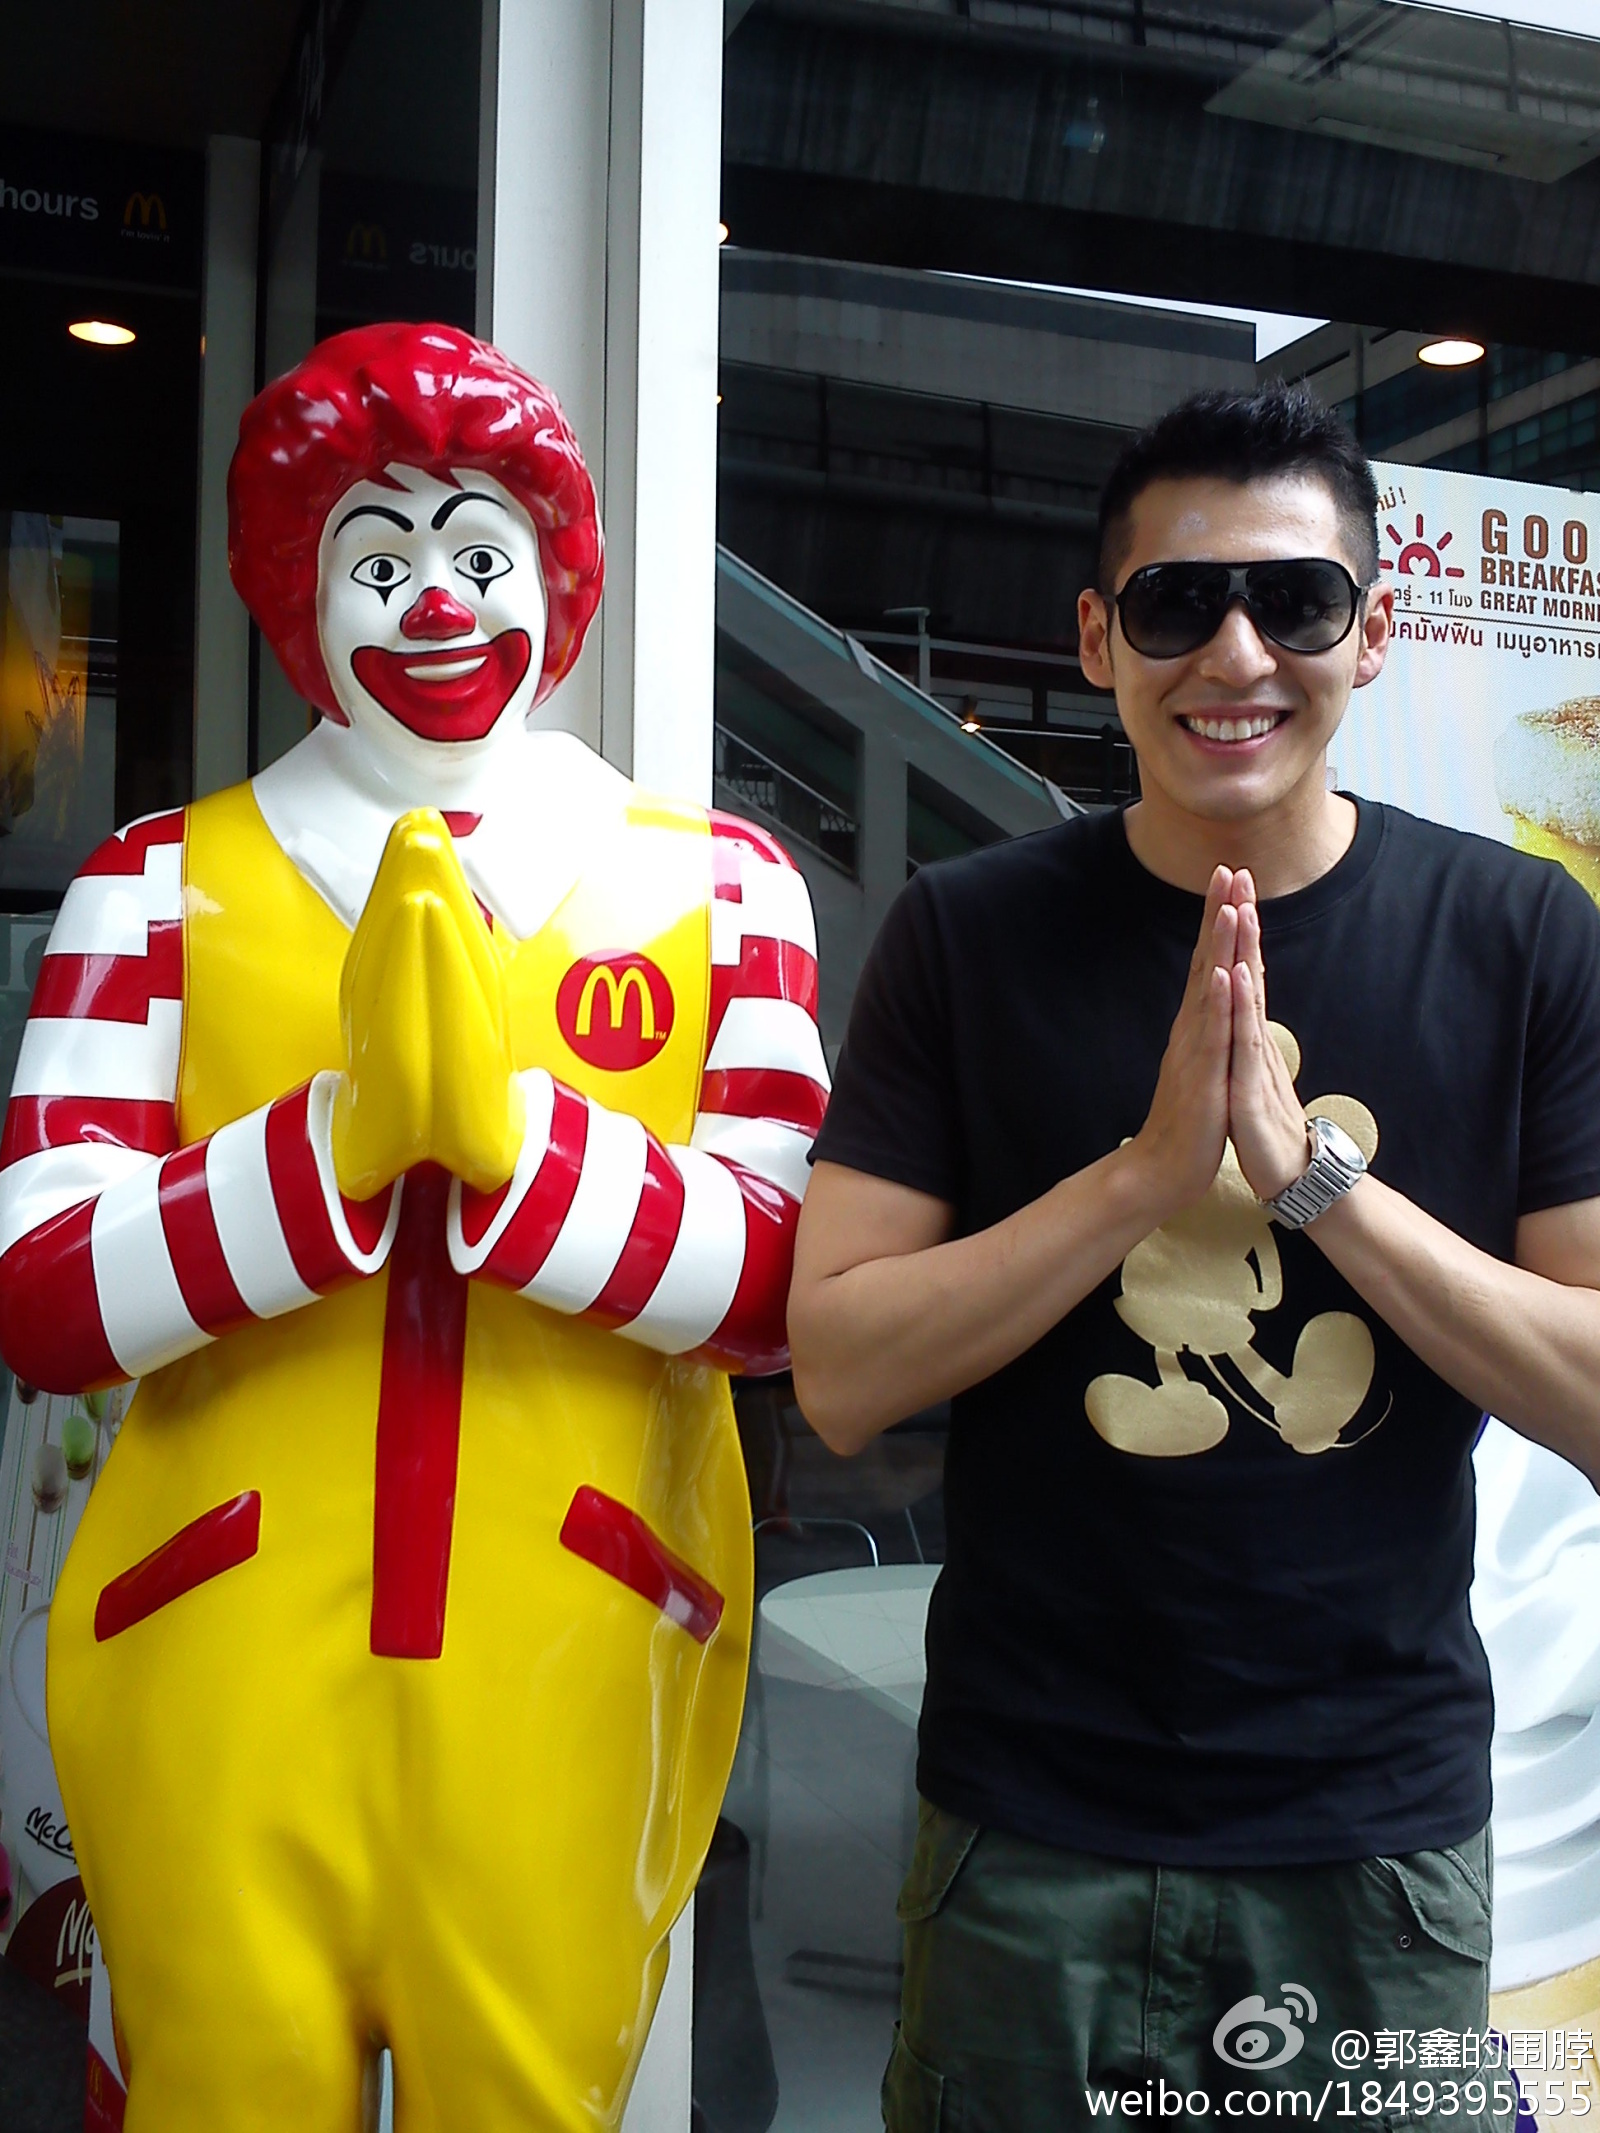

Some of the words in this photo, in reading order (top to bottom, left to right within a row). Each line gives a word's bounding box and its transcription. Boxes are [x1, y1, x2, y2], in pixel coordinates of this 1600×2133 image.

[0, 178, 99, 221] hours
[1482, 508, 1588, 565] GOO
[1430, 590, 1443, 605] 11
[1481, 590, 1537, 615] GREAT
